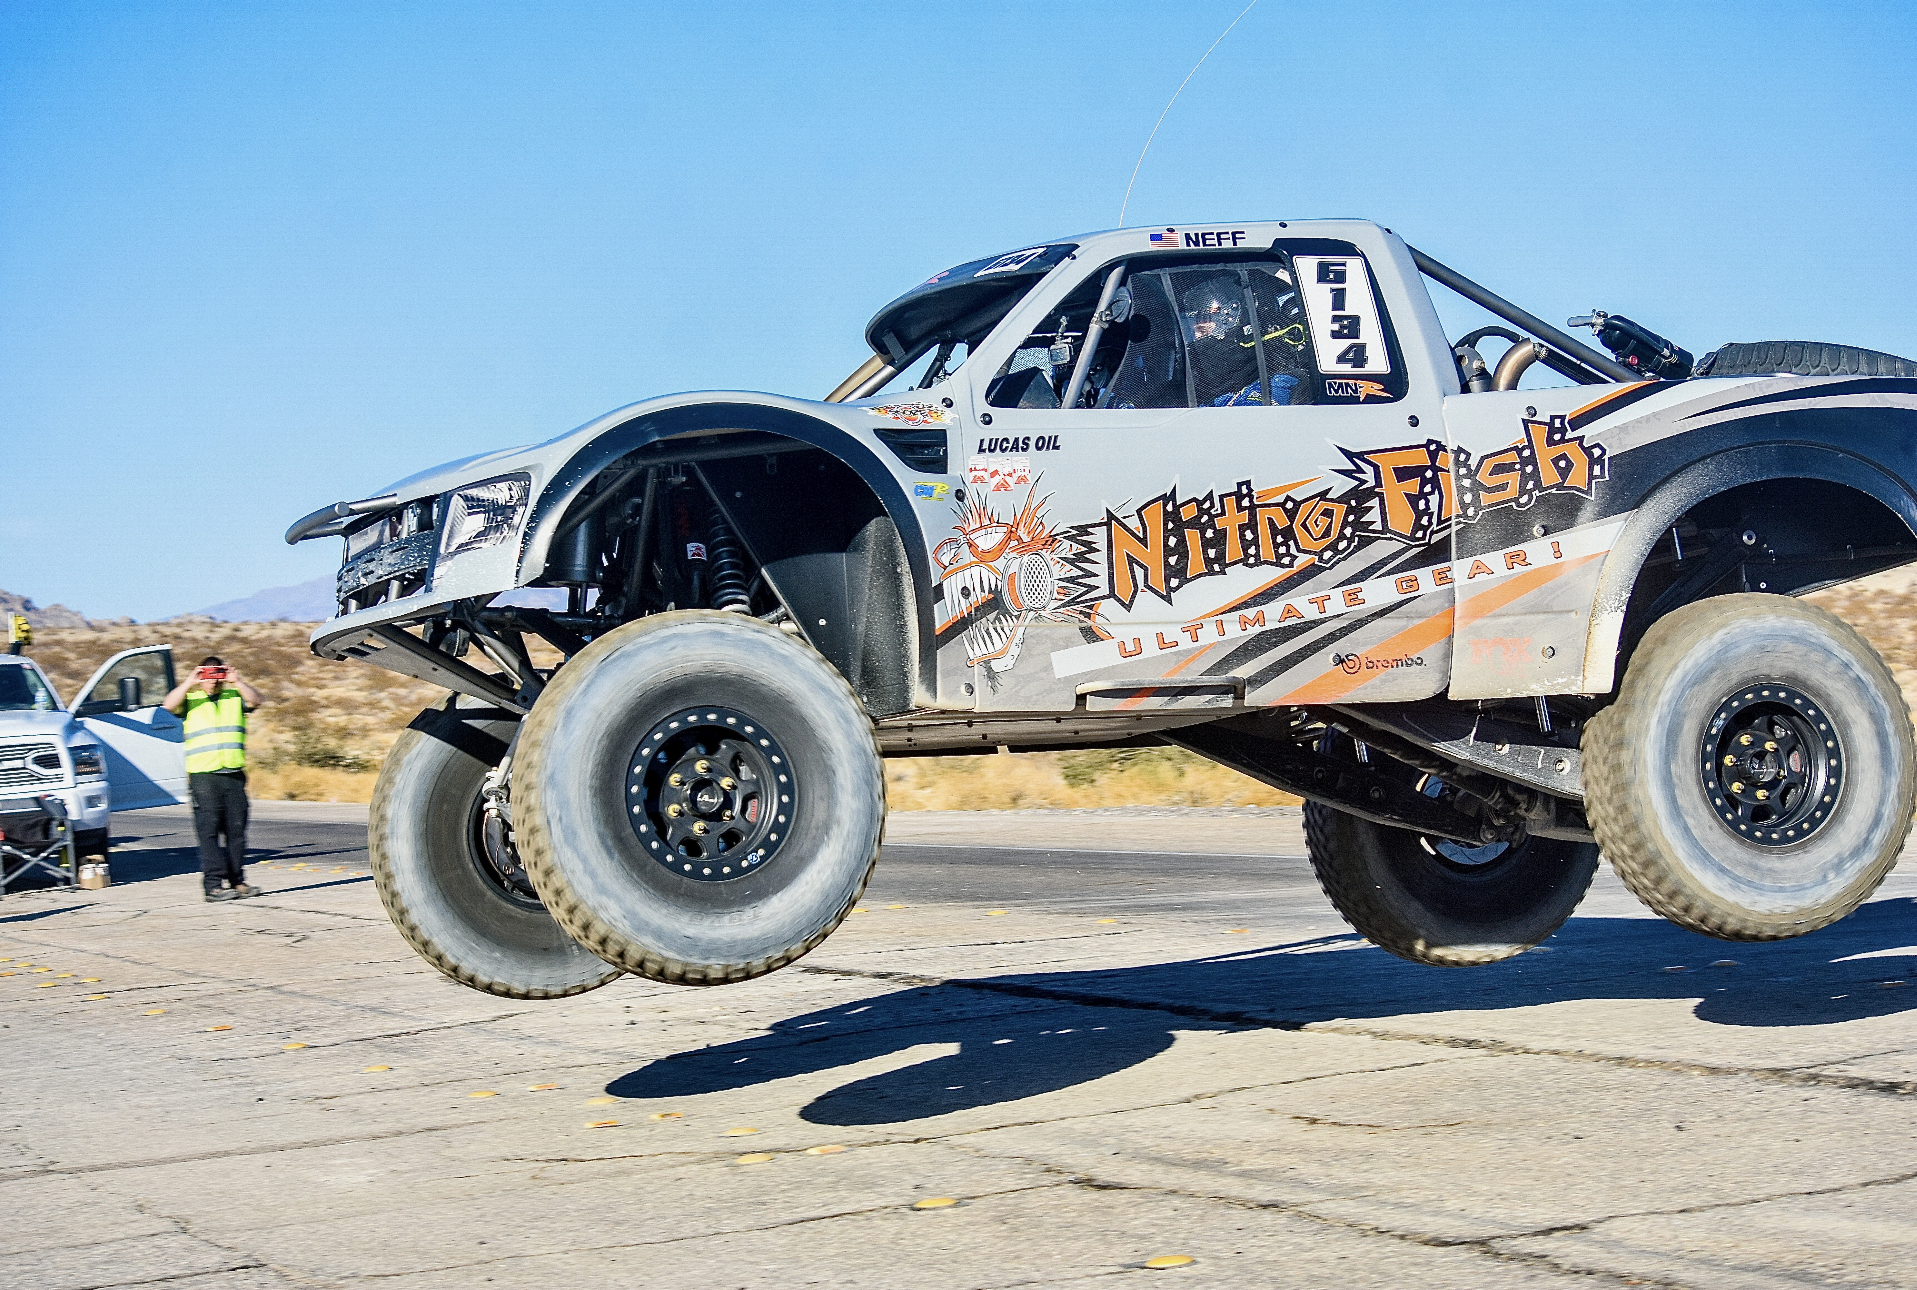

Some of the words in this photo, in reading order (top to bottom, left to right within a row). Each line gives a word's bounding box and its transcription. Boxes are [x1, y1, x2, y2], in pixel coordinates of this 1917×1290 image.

[1184, 231, 1246, 248] NEFF
[1316, 261, 1368, 368] 6134
[977, 436, 1031, 454] LUCAS
[1035, 434, 1061, 452] OIL
[1106, 480, 1356, 611] Nitro
[1340, 415, 1607, 543] Fish
[1118, 586, 1365, 658] ULTIMATE
[1470, 637, 1533, 665] FOX
